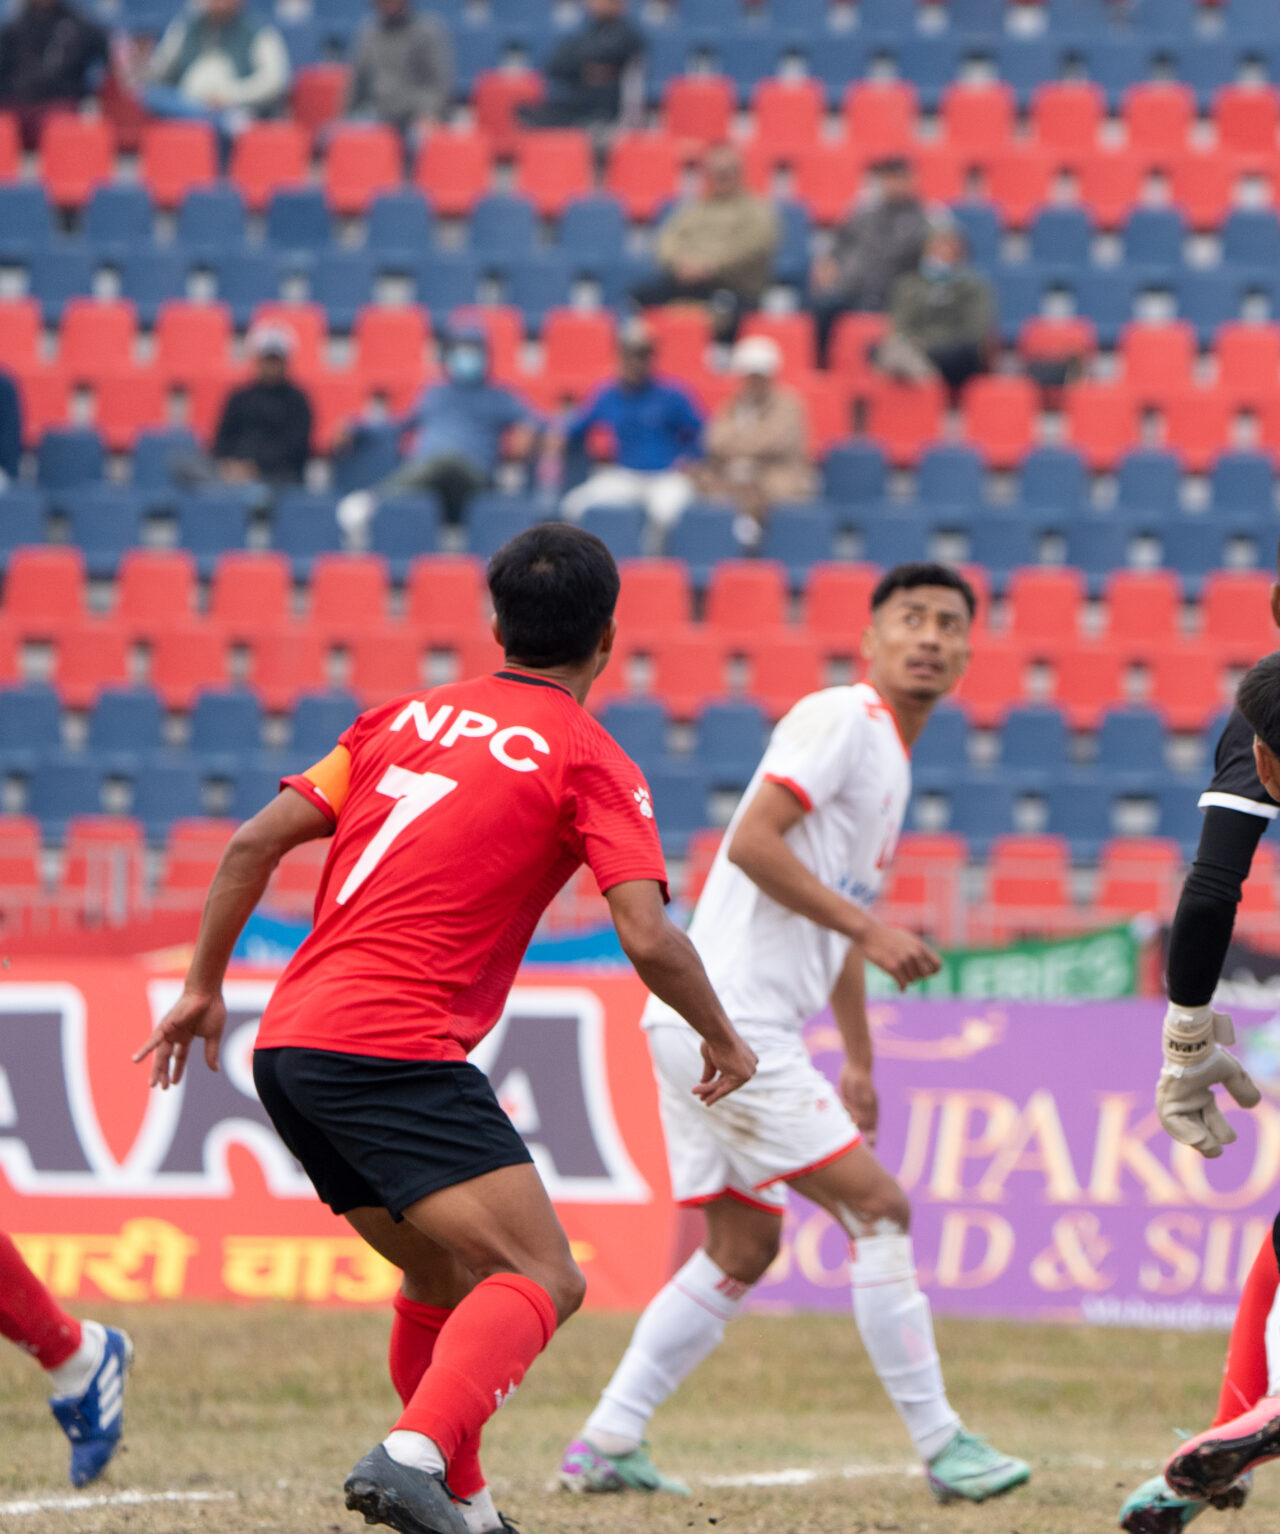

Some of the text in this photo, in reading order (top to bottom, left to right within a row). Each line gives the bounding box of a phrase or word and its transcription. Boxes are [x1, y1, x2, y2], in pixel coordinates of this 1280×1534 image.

[389, 699, 551, 773] NPC
[335, 763, 459, 907] 7
[1030, 1212, 1119, 1294] &
